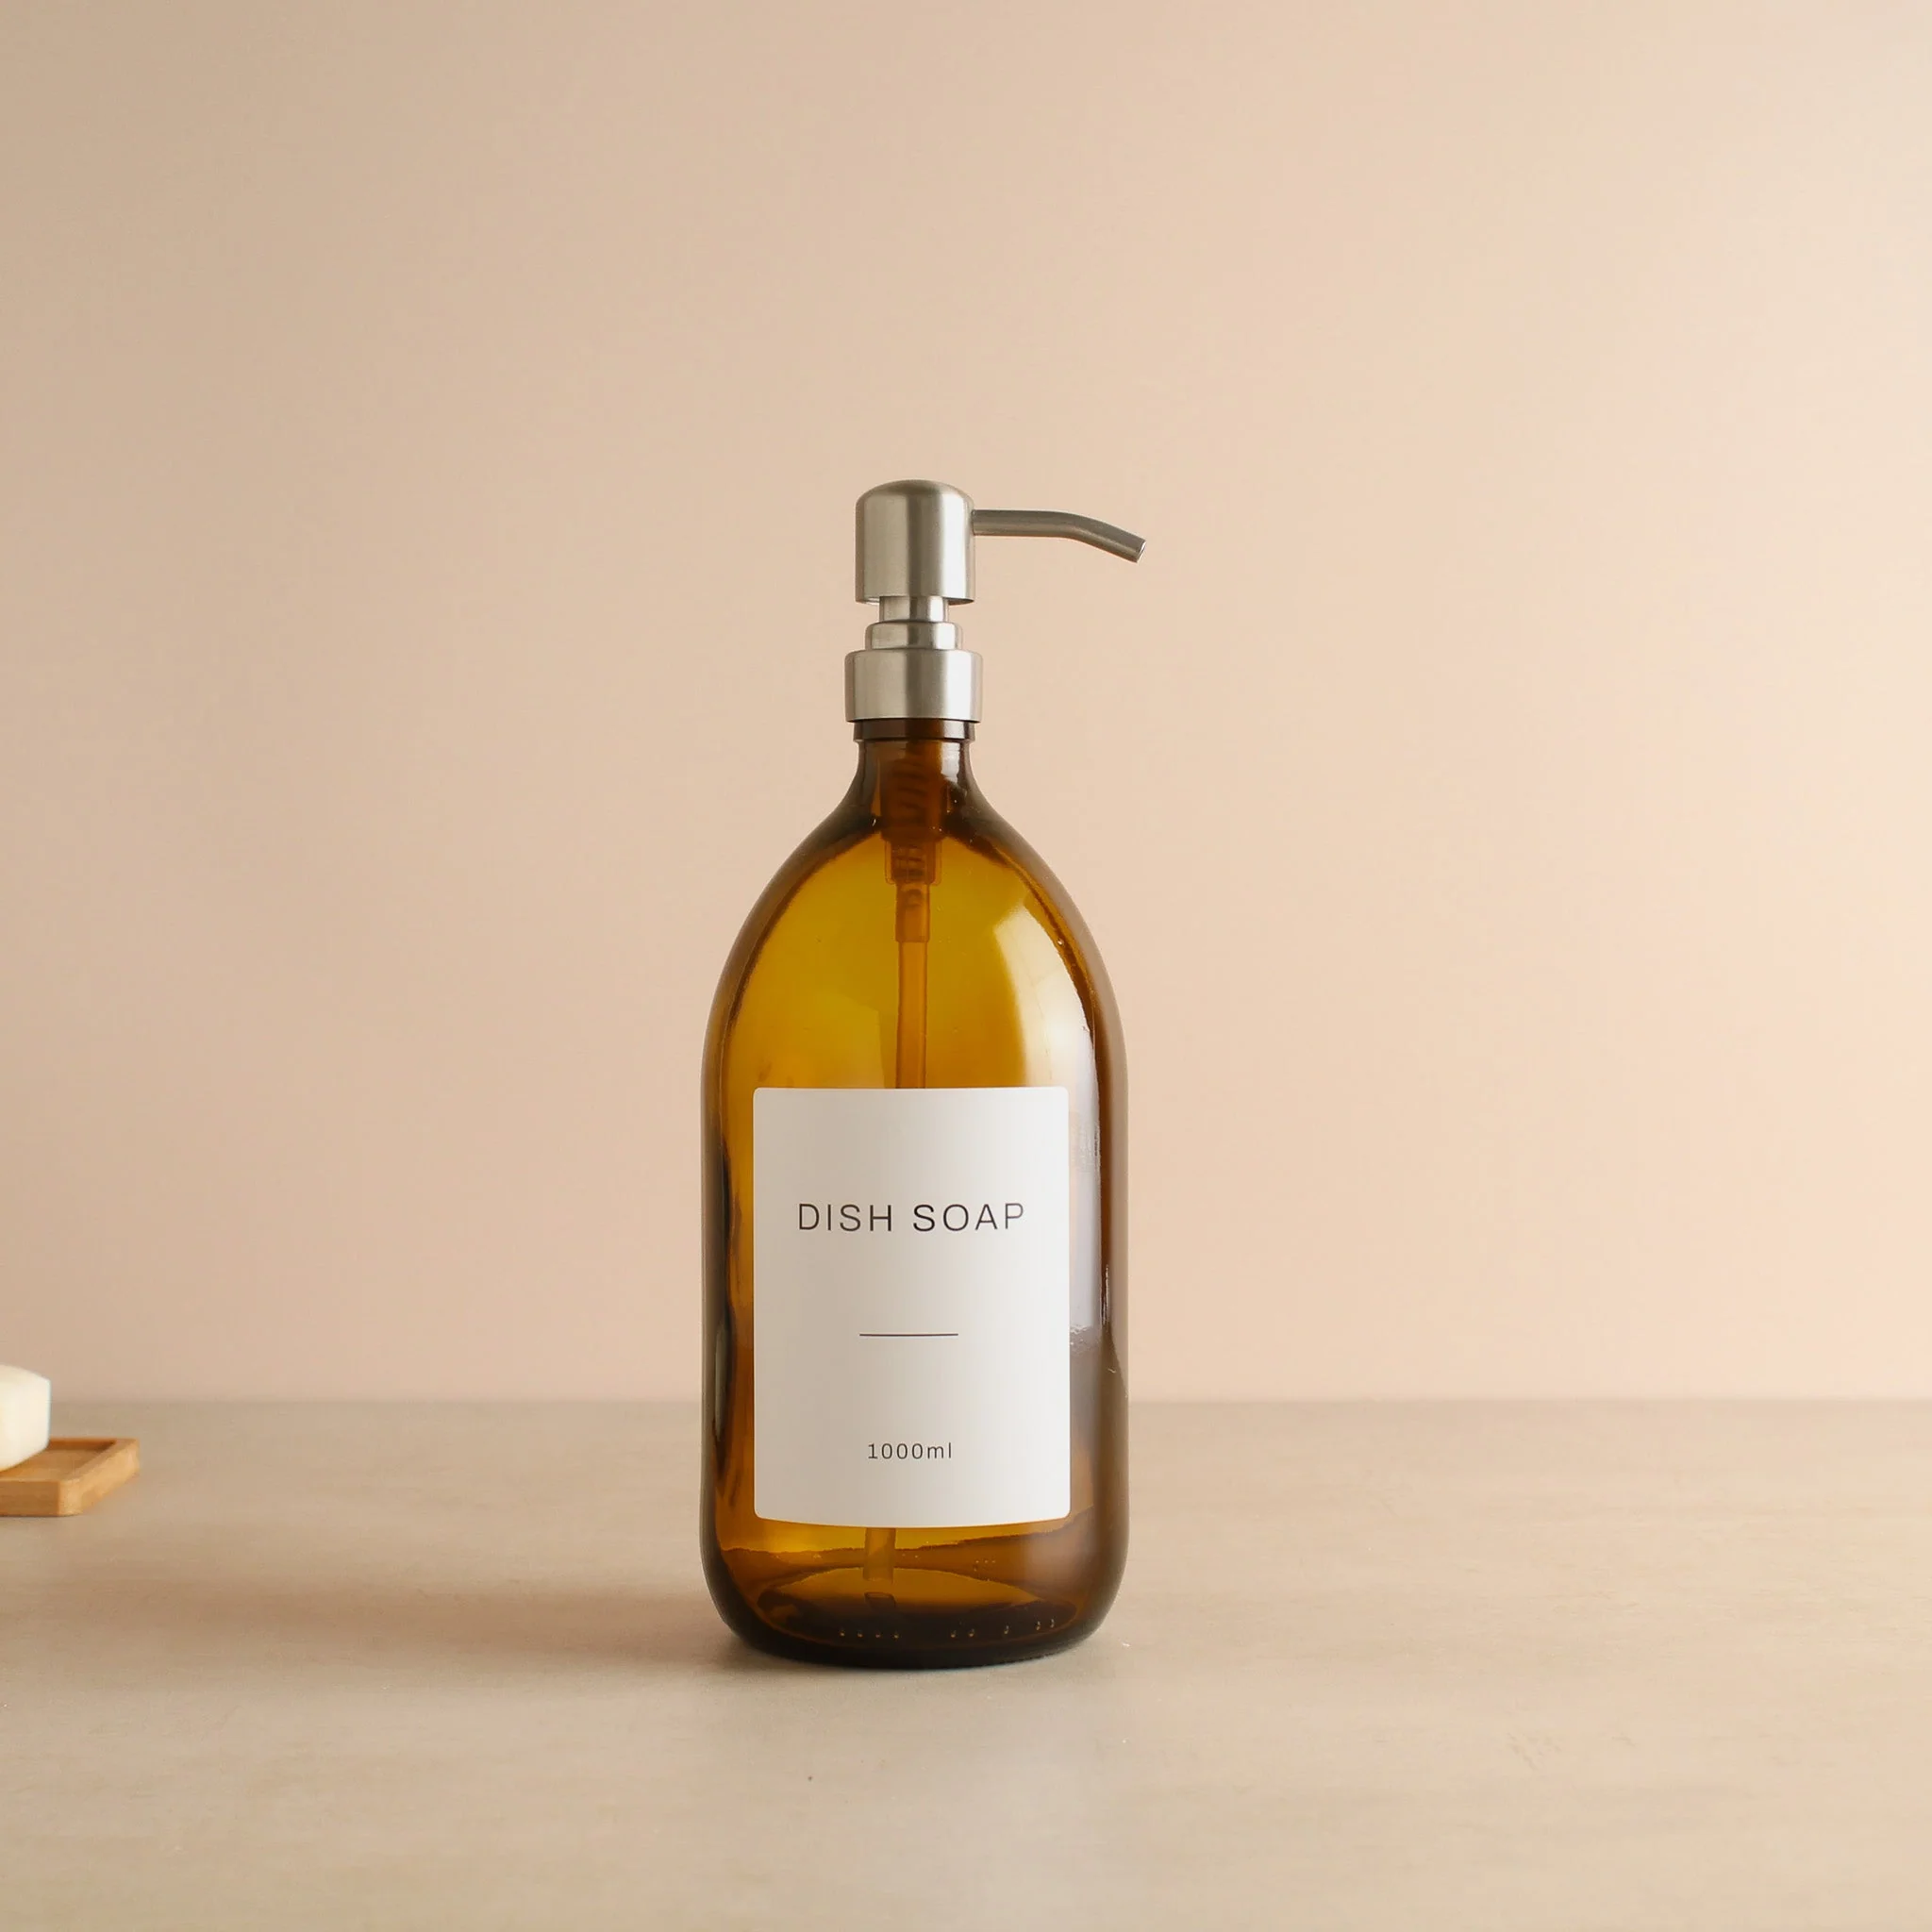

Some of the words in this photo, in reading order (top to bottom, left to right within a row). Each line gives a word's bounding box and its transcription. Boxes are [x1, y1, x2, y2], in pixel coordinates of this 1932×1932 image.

[797, 1202, 892, 1232] DISH
[912, 1203, 1024, 1232] SOAP
[867, 1441, 953, 1459] 1000ml
